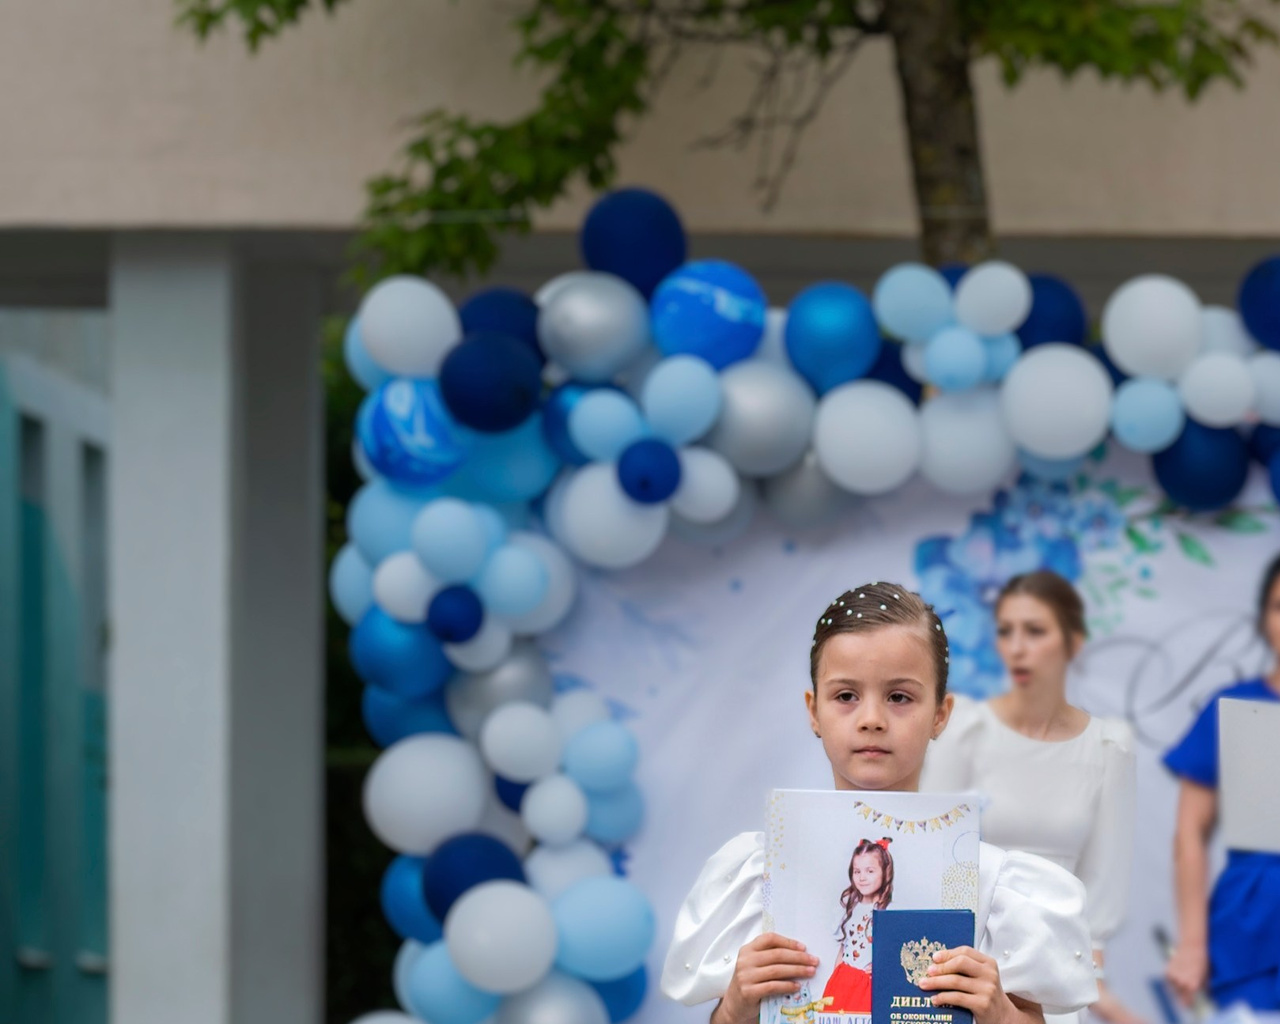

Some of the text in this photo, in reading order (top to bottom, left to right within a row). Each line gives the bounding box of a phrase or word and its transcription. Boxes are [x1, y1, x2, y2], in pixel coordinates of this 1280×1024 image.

[890, 996, 953, 1009] ДИПЛ
[890, 1012, 953, 1022] ОБ ОКОНЧАНИИ
